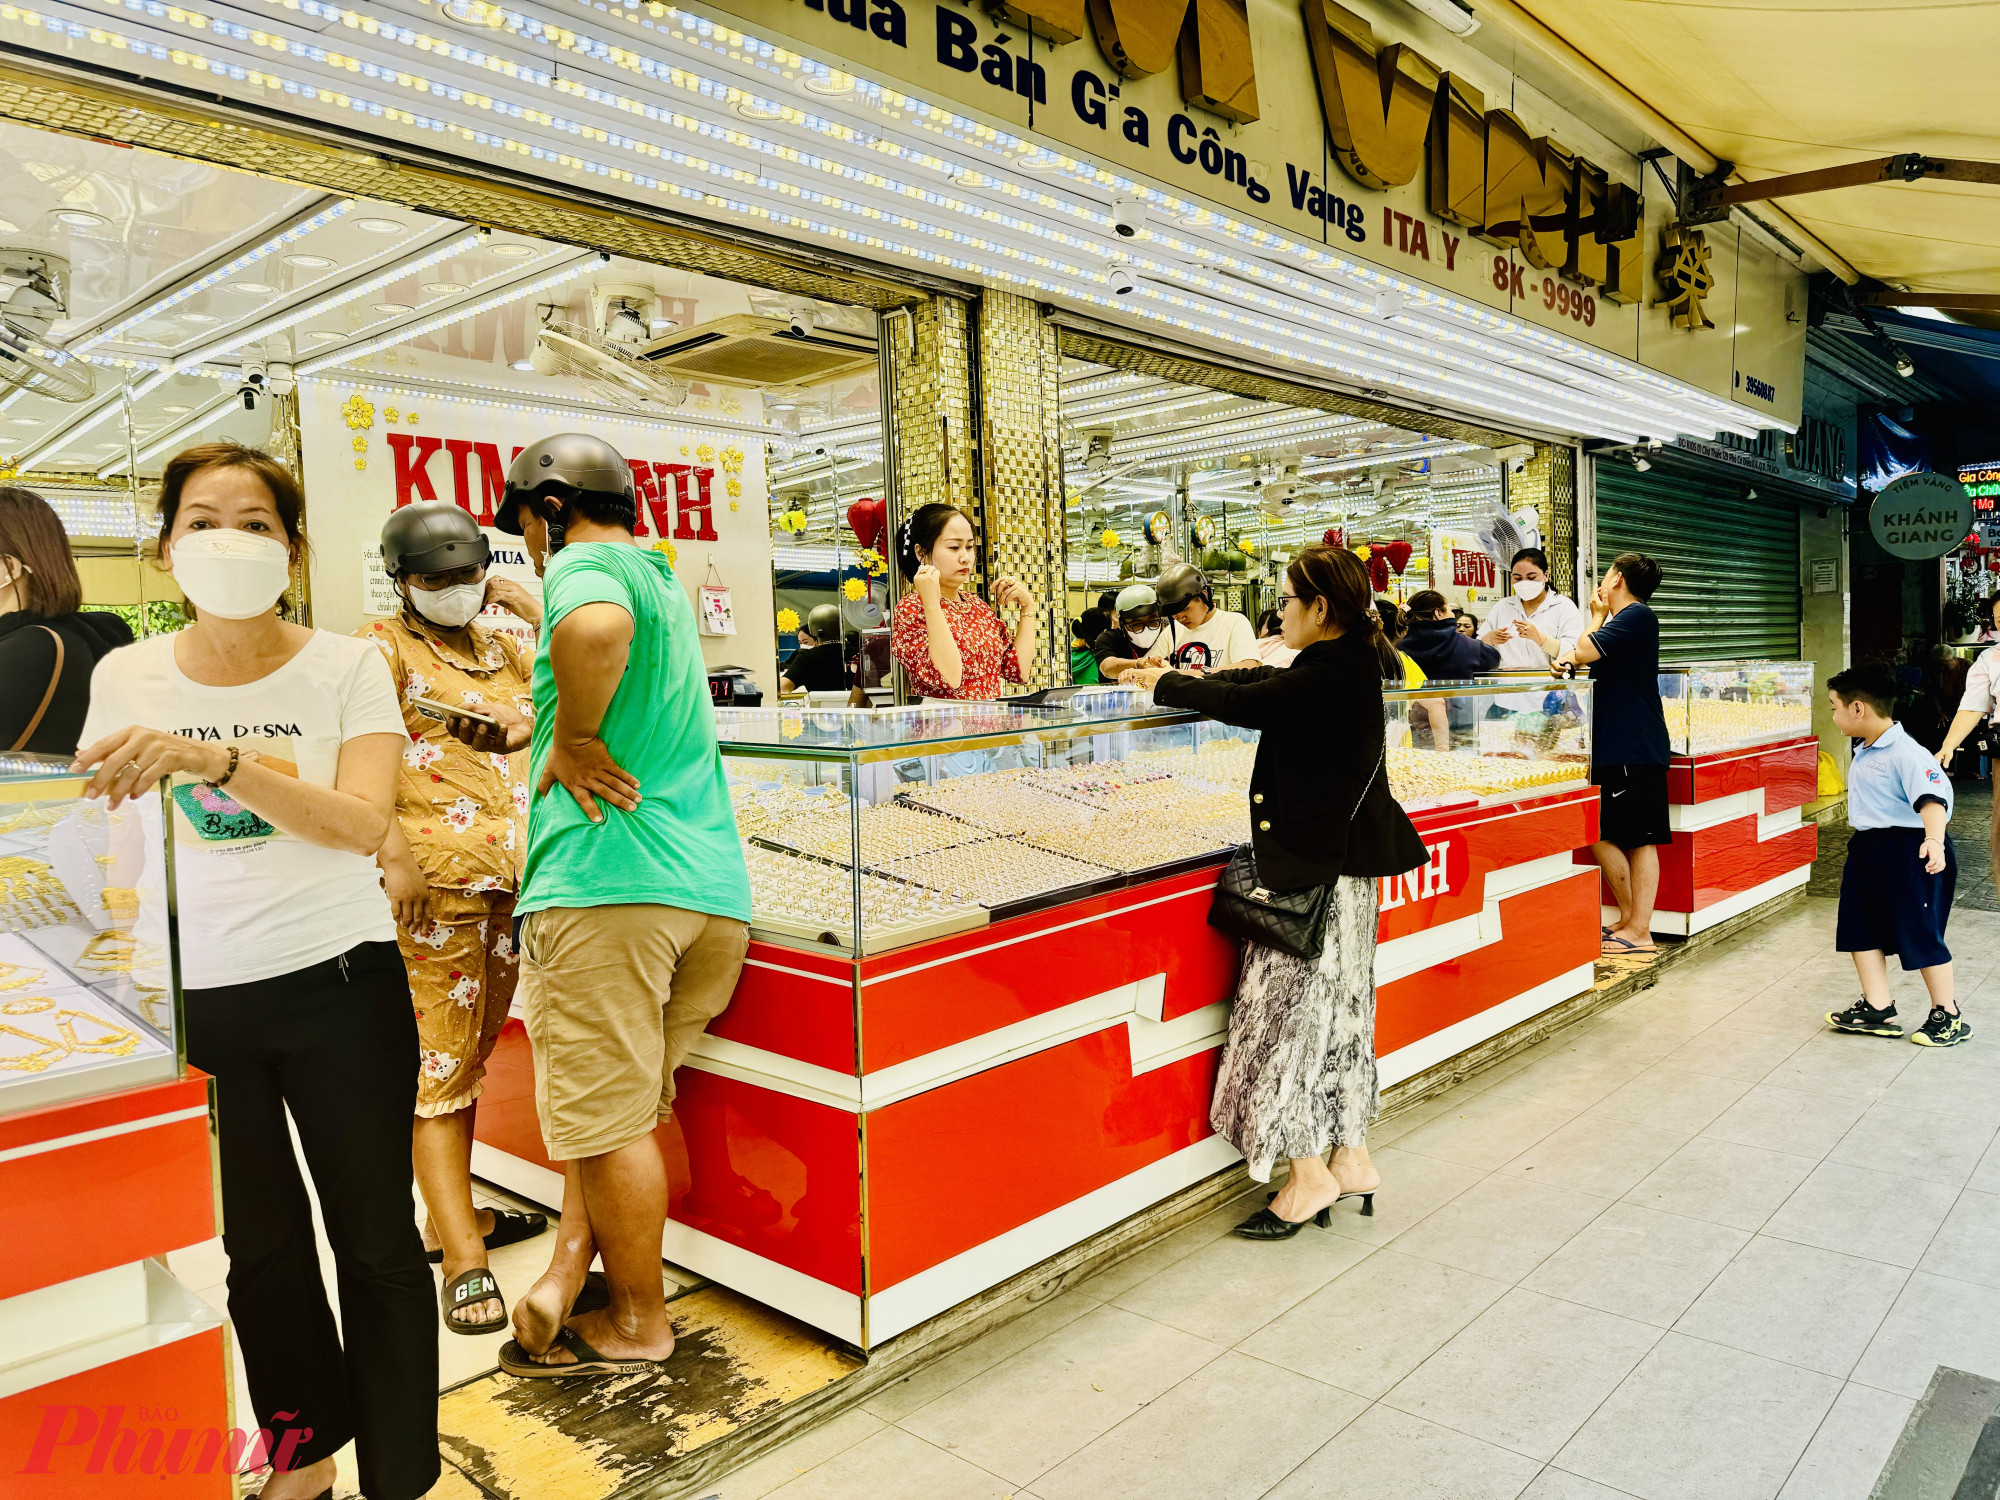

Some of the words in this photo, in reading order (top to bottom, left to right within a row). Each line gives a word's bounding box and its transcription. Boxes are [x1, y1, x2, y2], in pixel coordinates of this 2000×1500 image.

[797, 0, 908, 48] ua
[936, 4, 1047, 105] Bán
[1542, 277, 1597, 328] 9999
[1959, 472, 1977, 483] Gia
[1978, 470, 2000, 482] Côn
[1892, 479, 1919, 494] TIỆM
[1923, 477, 1953, 493] VÀNG
[1978, 483, 2000, 496] Chữ
[1883, 507, 1958, 527] KHÁNH
[1886, 528, 1955, 545] GIANG
[489, 551, 526, 565] MUA
[202, 813, 269, 837] Brid
[455, 1277, 495, 1302] GEN
